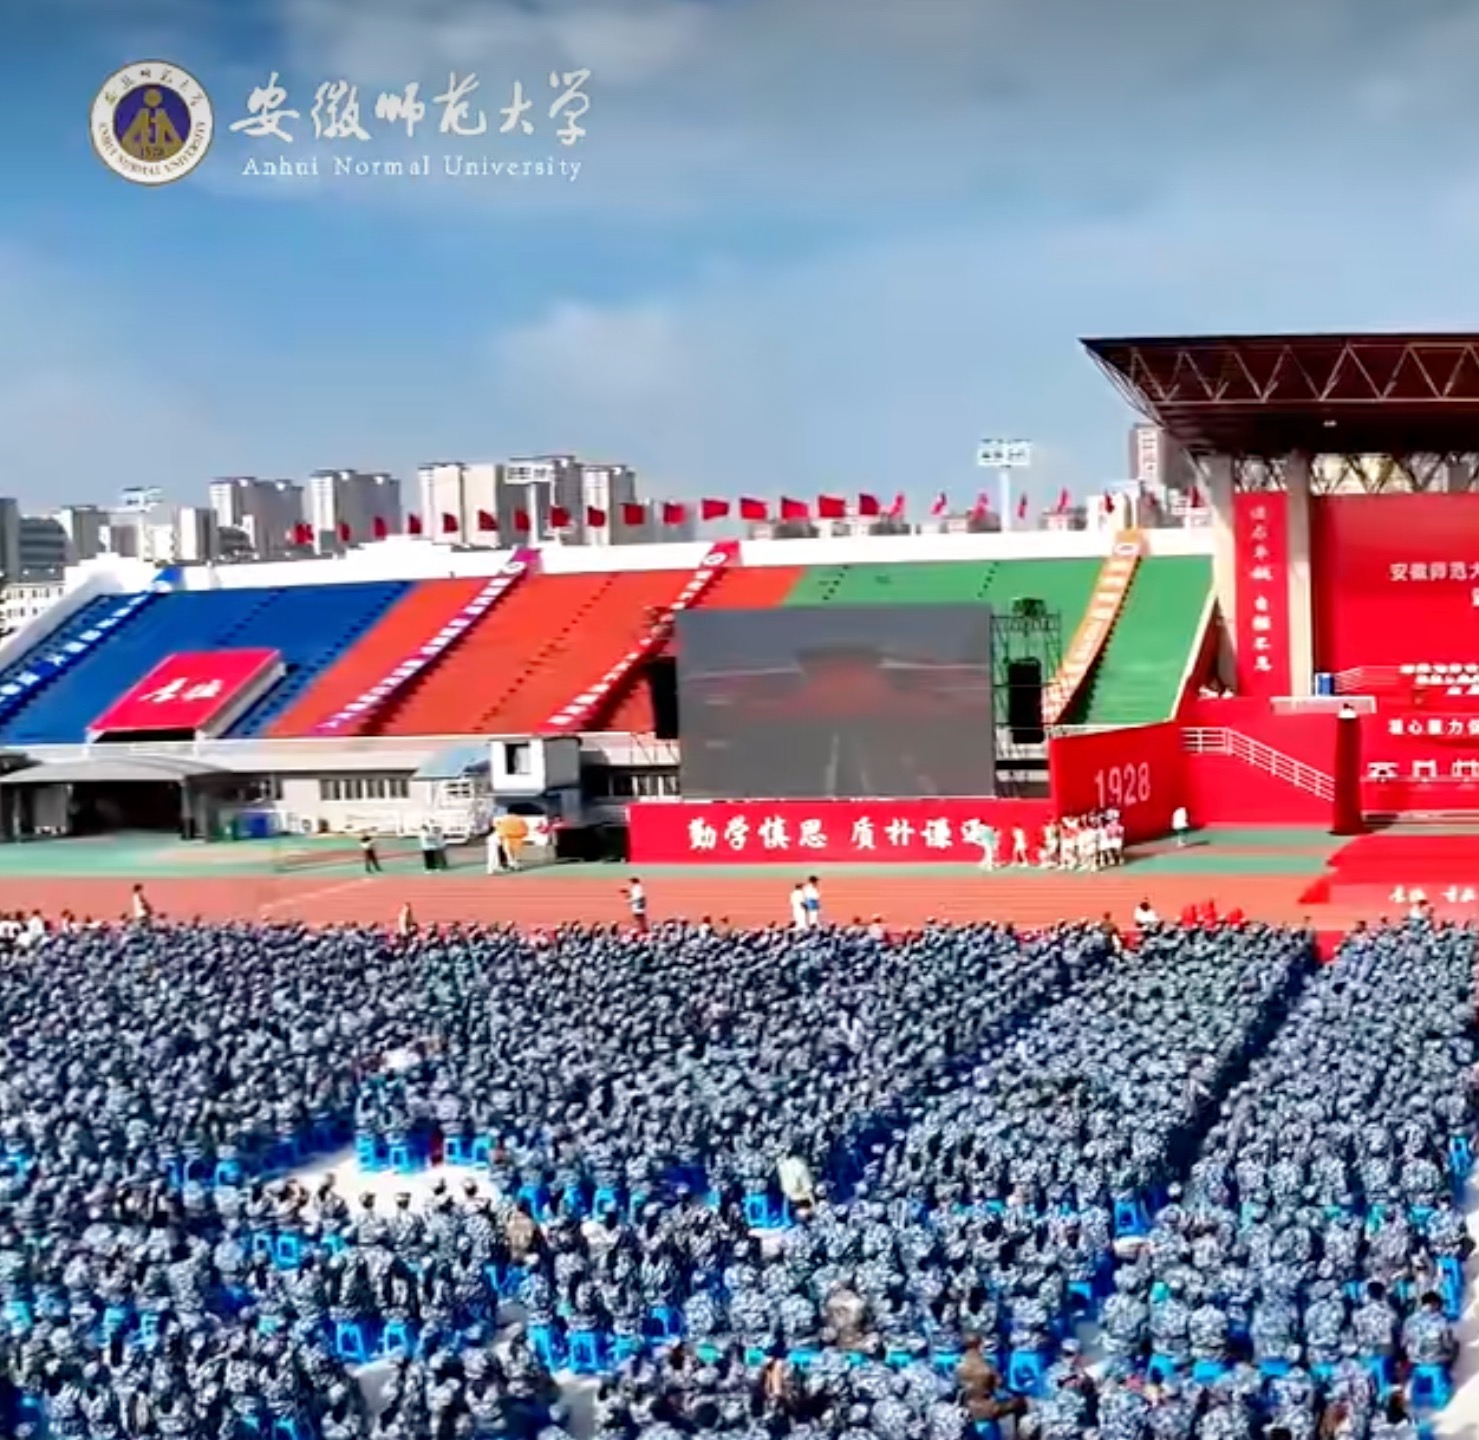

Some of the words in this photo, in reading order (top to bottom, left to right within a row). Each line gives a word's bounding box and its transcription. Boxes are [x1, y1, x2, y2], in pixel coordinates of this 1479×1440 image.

[1094, 761, 1151, 808] 1928
[687, 814, 828, 851] 勤学慎思
